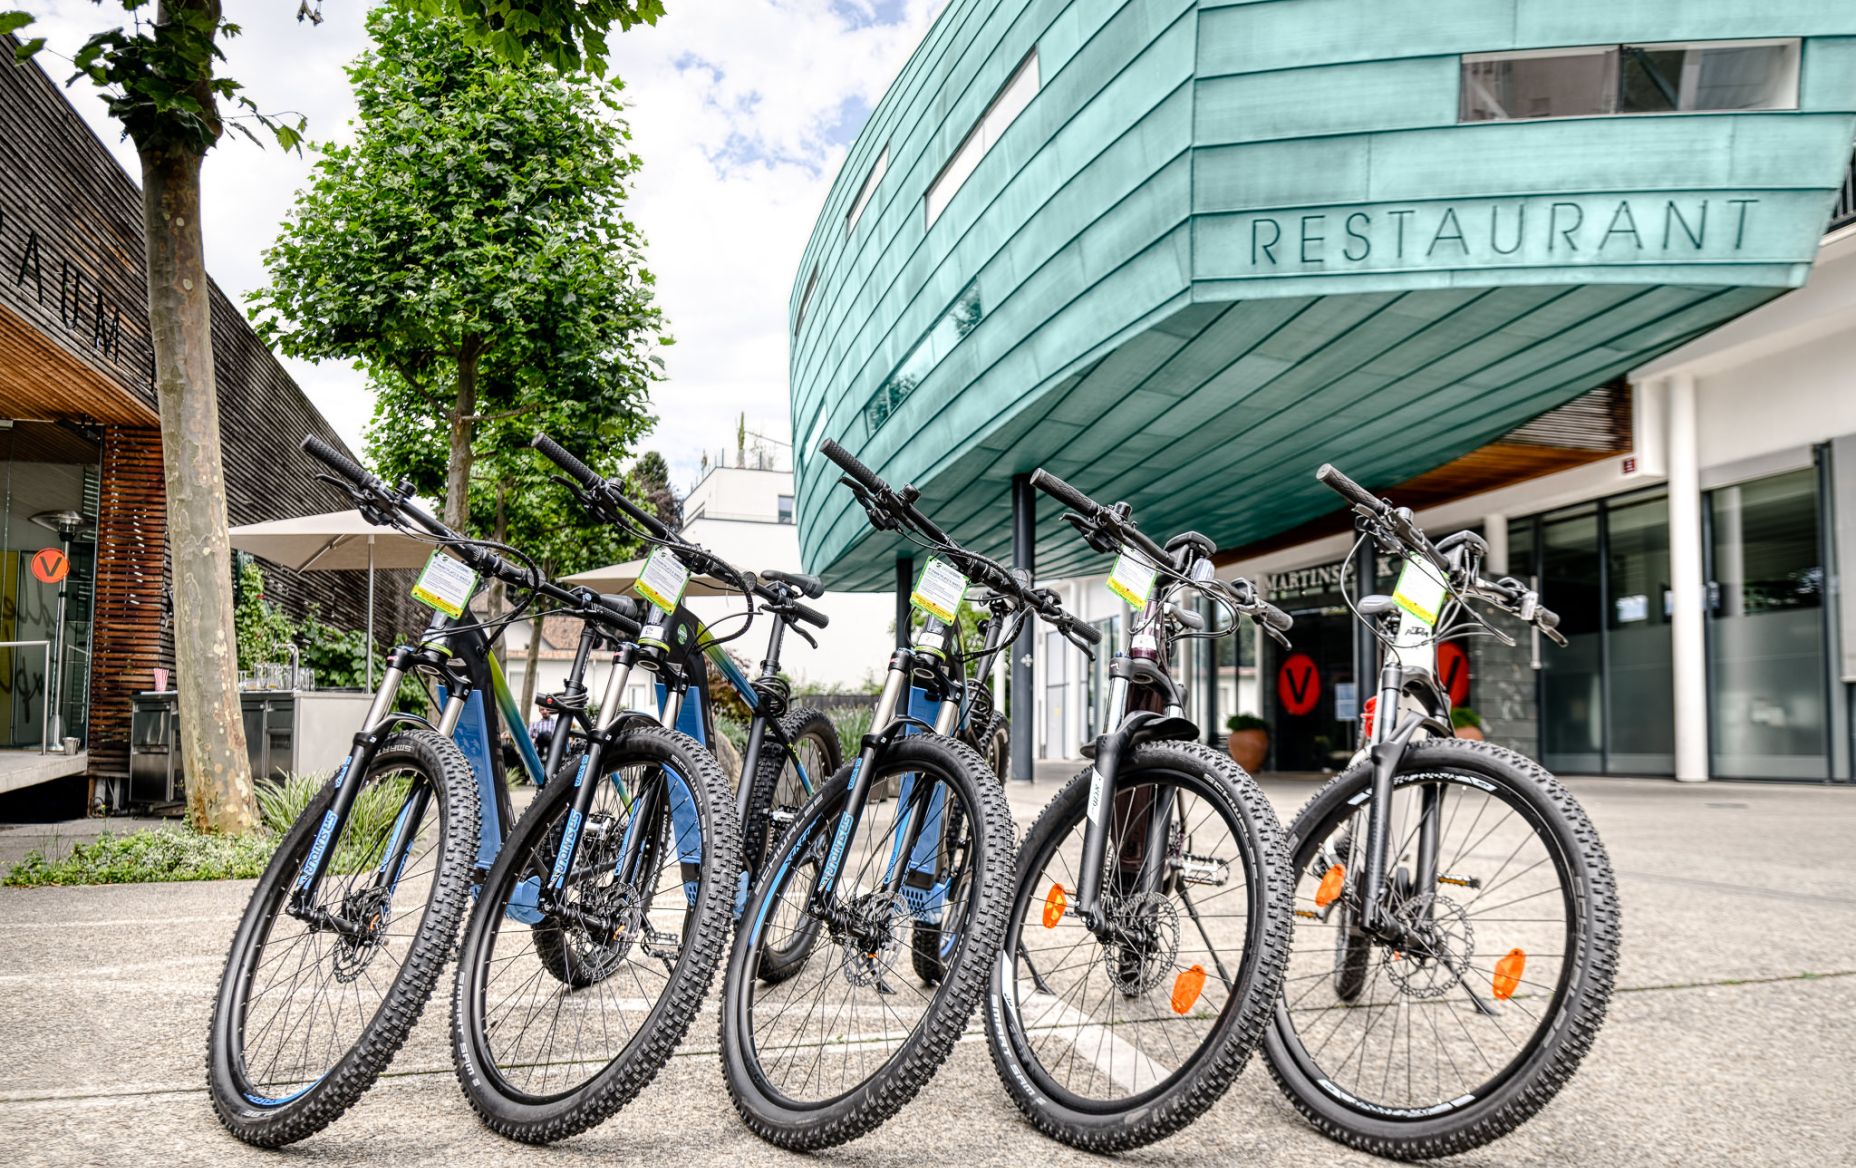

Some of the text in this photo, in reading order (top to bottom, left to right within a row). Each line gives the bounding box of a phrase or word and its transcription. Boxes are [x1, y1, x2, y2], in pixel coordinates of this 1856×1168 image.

[1250, 199, 1760, 265] RESTAURANT
[39, 556, 63, 577] V
[1285, 666, 1312, 704] V
[304, 830, 330, 875] SUNTOUR
[555, 830, 576, 873] SUNTOUR
[754, 793, 823, 895] SCHWALBE
[456, 971, 475, 1076] SMART SAM
[991, 993, 1036, 1096] SMART SAM
